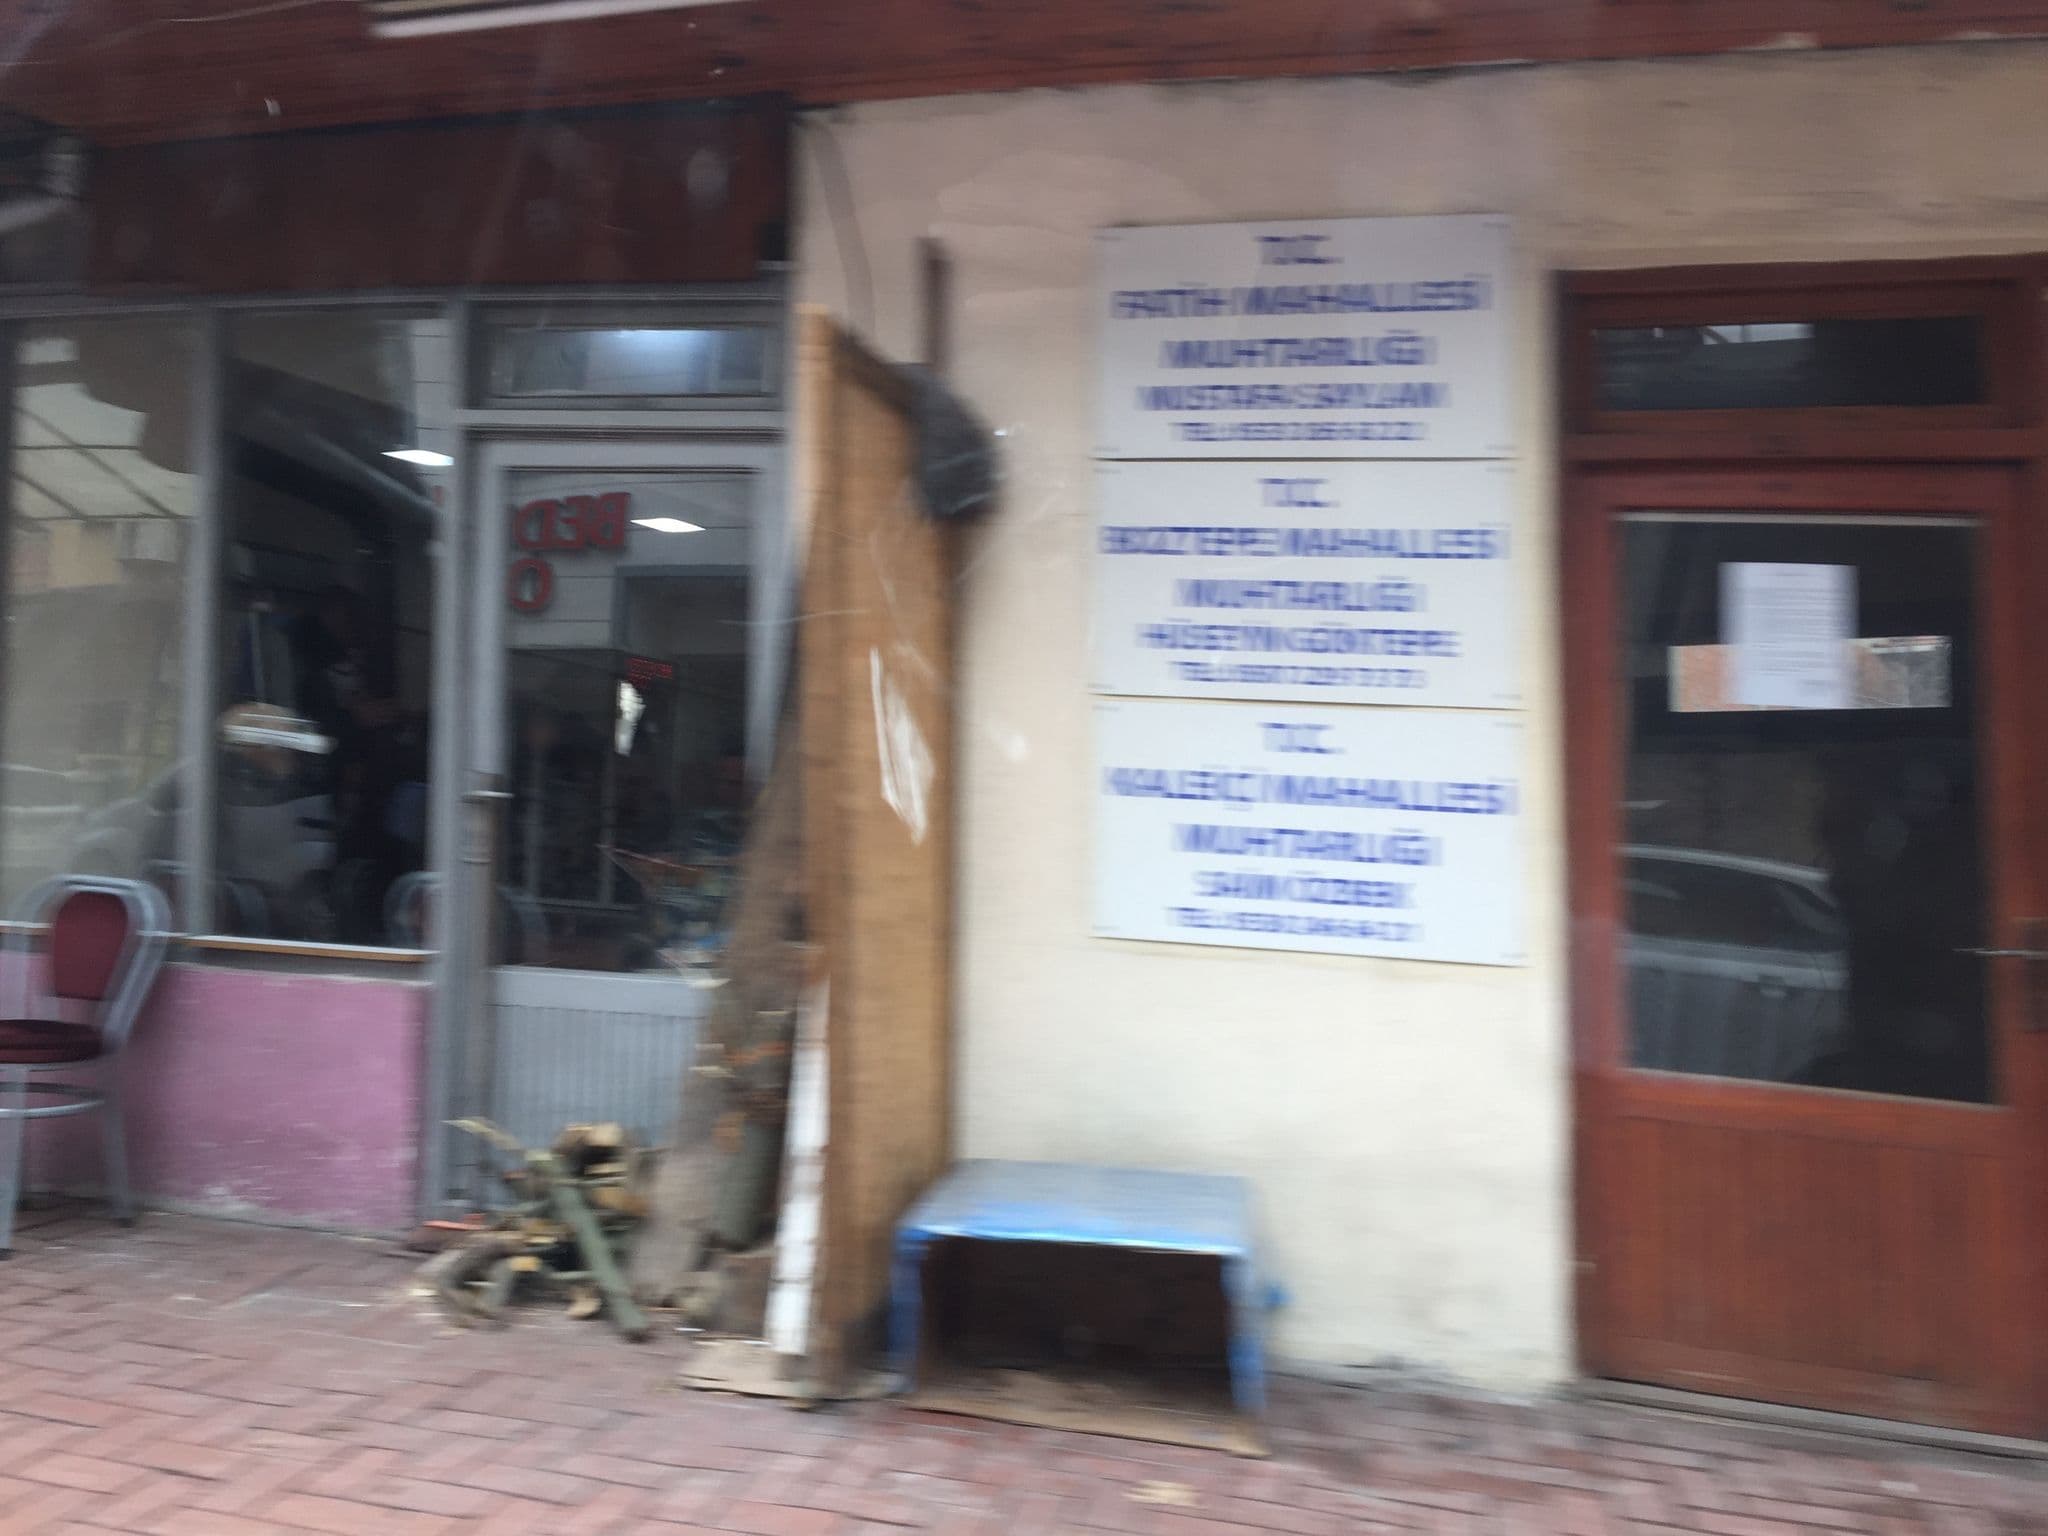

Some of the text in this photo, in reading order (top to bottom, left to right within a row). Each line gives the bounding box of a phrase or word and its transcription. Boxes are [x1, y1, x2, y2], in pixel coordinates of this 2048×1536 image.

[1240, 274, 1490, 314] MAHALLESİ
[1161, 329, 1436, 368] MUHTARLIĞI
[1278, 523, 1509, 559] MAHALLESİ
[1174, 576, 1428, 612] MUHTARLIĞI
[1271, 774, 1517, 815] MAHALLESİ
[1171, 824, 1441, 866] MUHTARLIĞI
